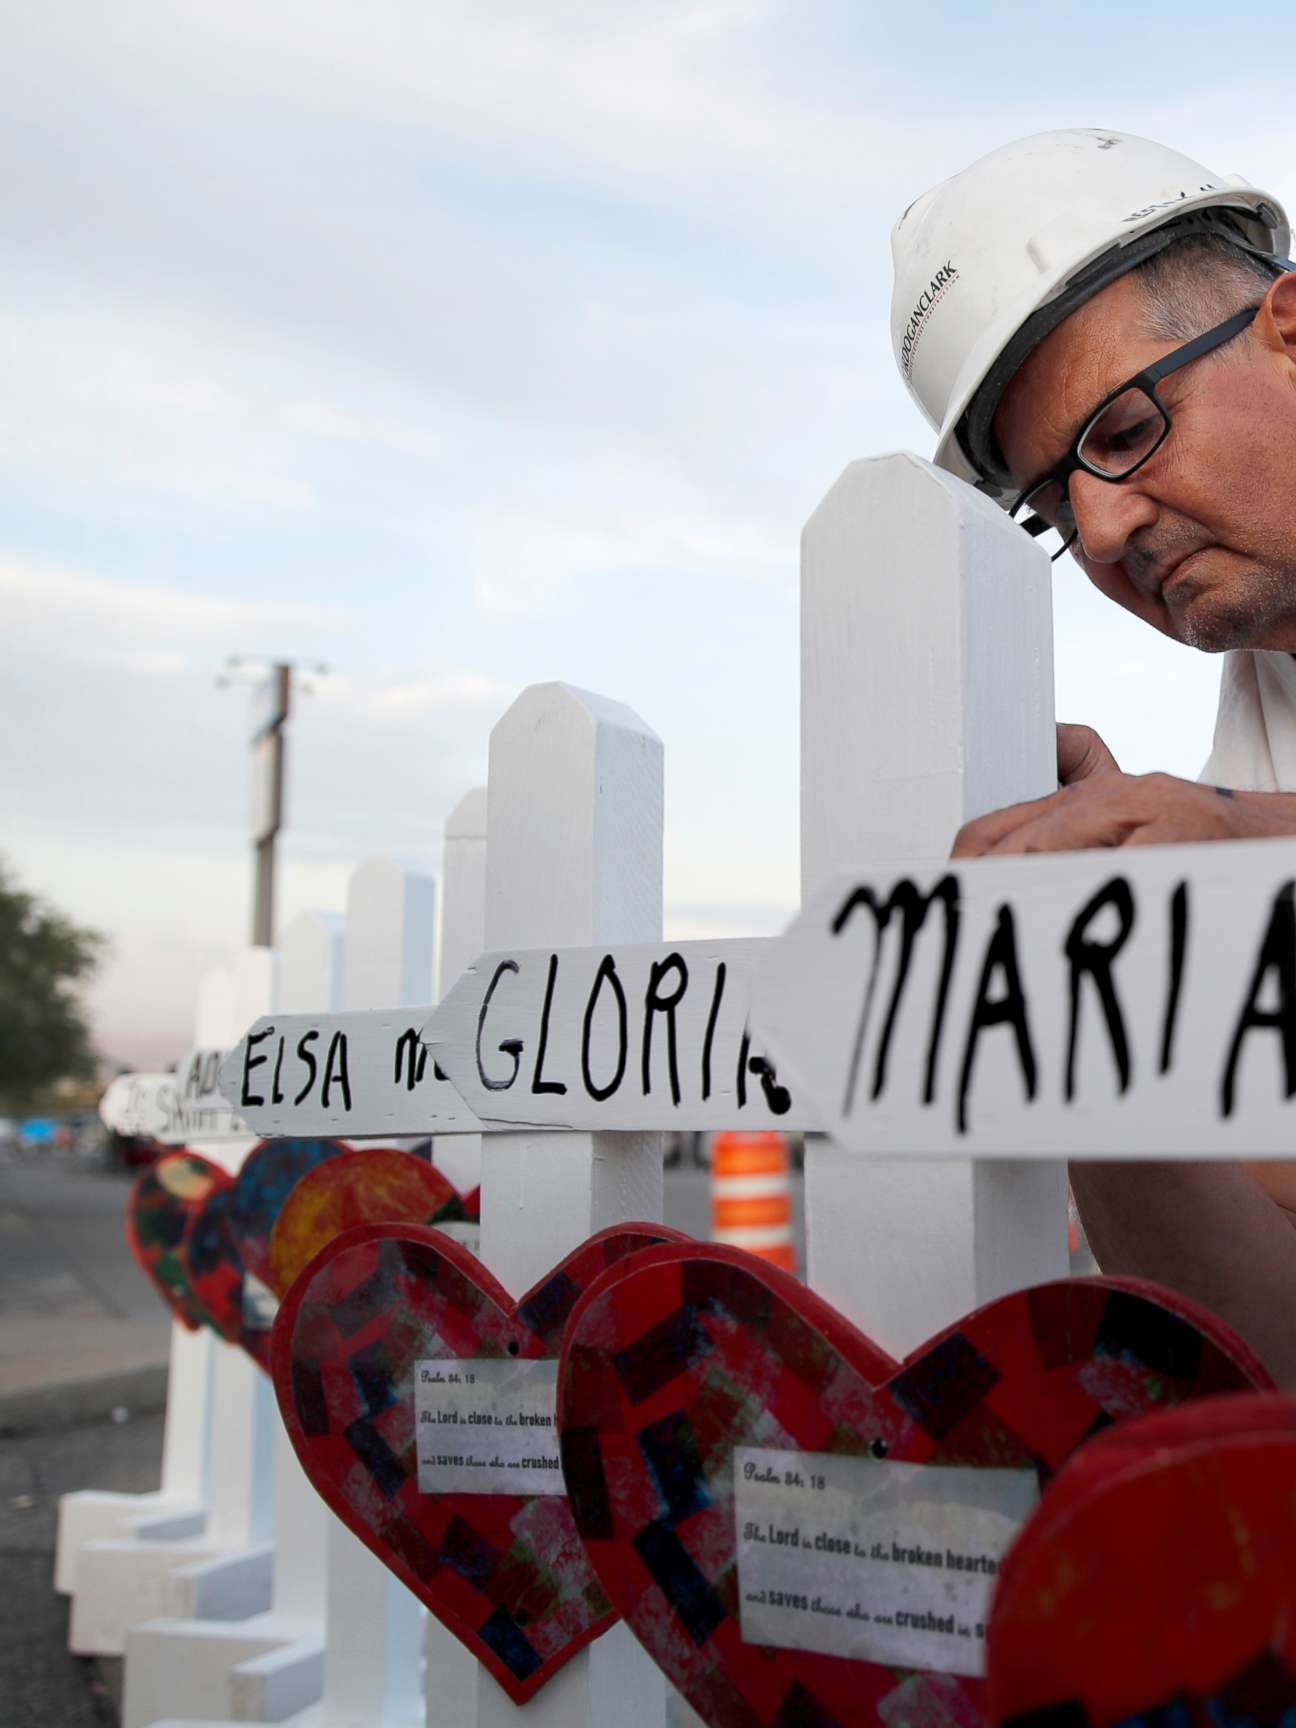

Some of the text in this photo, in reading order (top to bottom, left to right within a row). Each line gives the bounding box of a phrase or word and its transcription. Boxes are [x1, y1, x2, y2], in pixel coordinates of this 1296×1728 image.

[241, 1026, 352, 1112] ELSA
[394, 1027, 451, 1092] M
[420, 1369, 446, 1383] Psalm
[437, 1410, 458, 1425] Lord
[468, 1411, 493, 1425] close
[519, 1412, 552, 1427] broken
[437, 1455, 464, 1466] saves
[522, 1456, 559, 1470] crushed
[743, 1461, 781, 1485] Psalm
[810, 1474, 826, 1491] 18
[768, 1523, 800, 1548] Lord
[814, 1531, 851, 1555] close
[892, 1541, 943, 1569] broken
[946, 1549, 1000, 1576] hearte
[768, 1590, 809, 1612] saves
[895, 1610, 955, 1635] crushed
[975, 1622, 986, 1640] s
